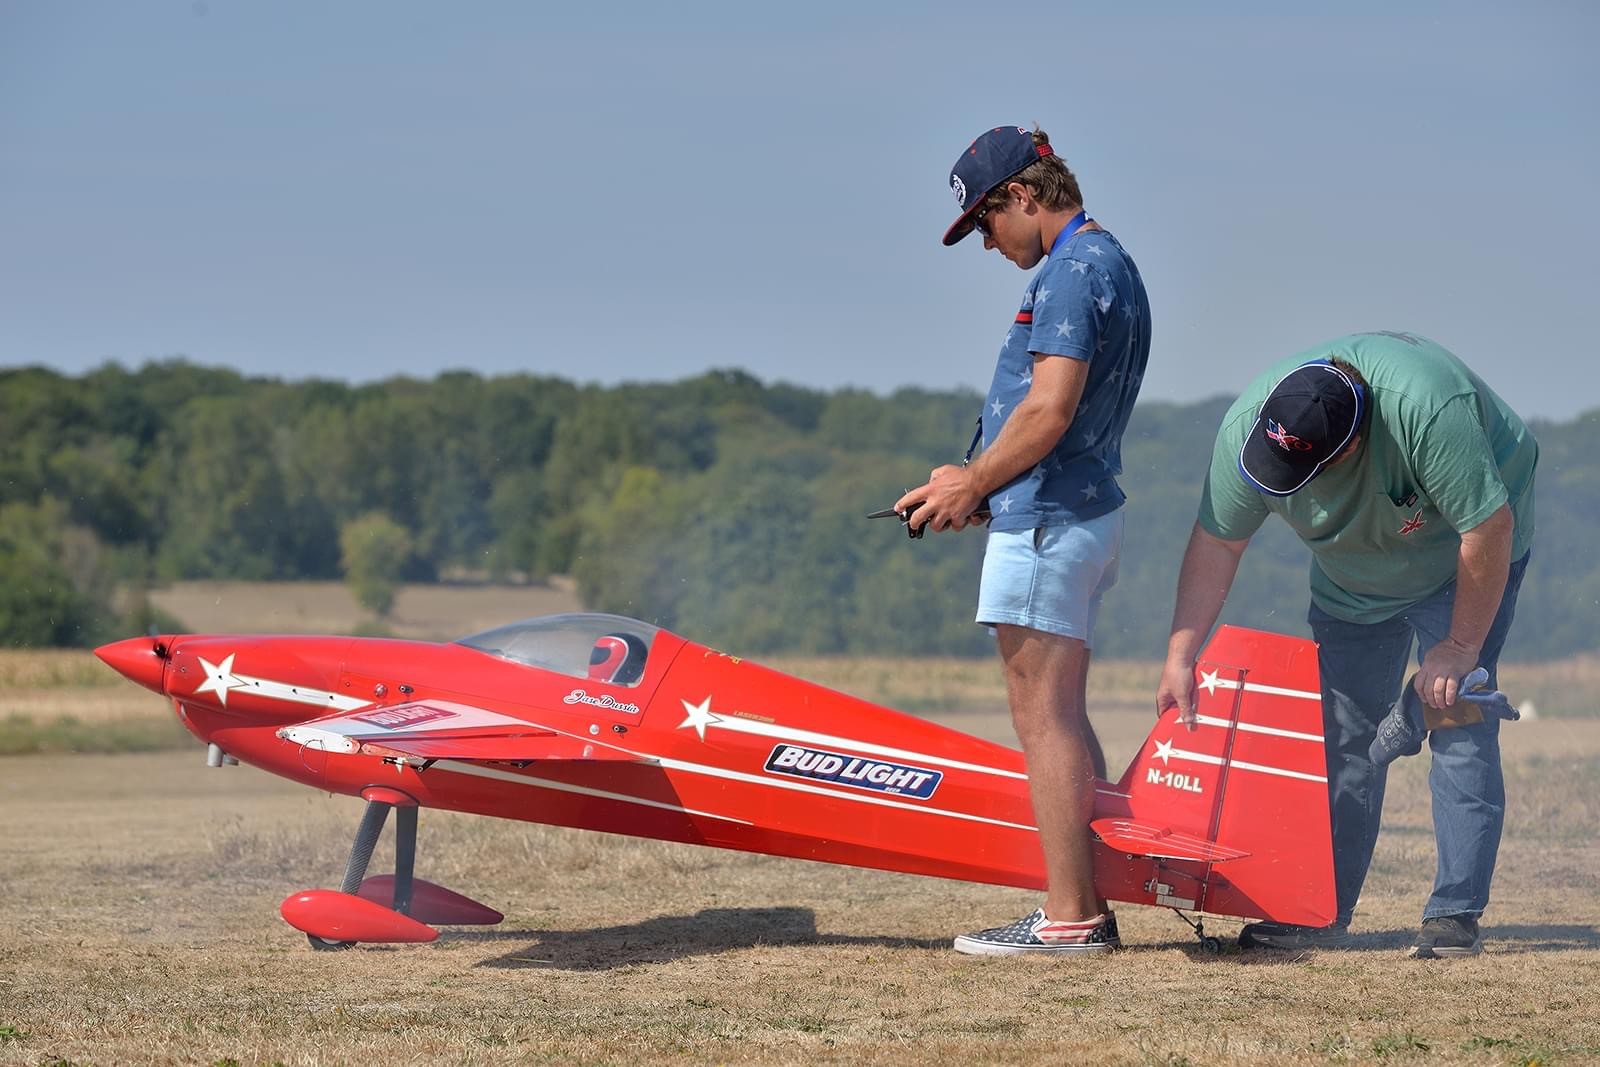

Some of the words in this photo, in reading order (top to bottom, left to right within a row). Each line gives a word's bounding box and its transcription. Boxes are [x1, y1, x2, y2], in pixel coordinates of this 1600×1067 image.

[773, 746, 843, 774] BUD
[839, 759, 934, 790] LIGHT
[1146, 768, 1203, 793] N-10LL
